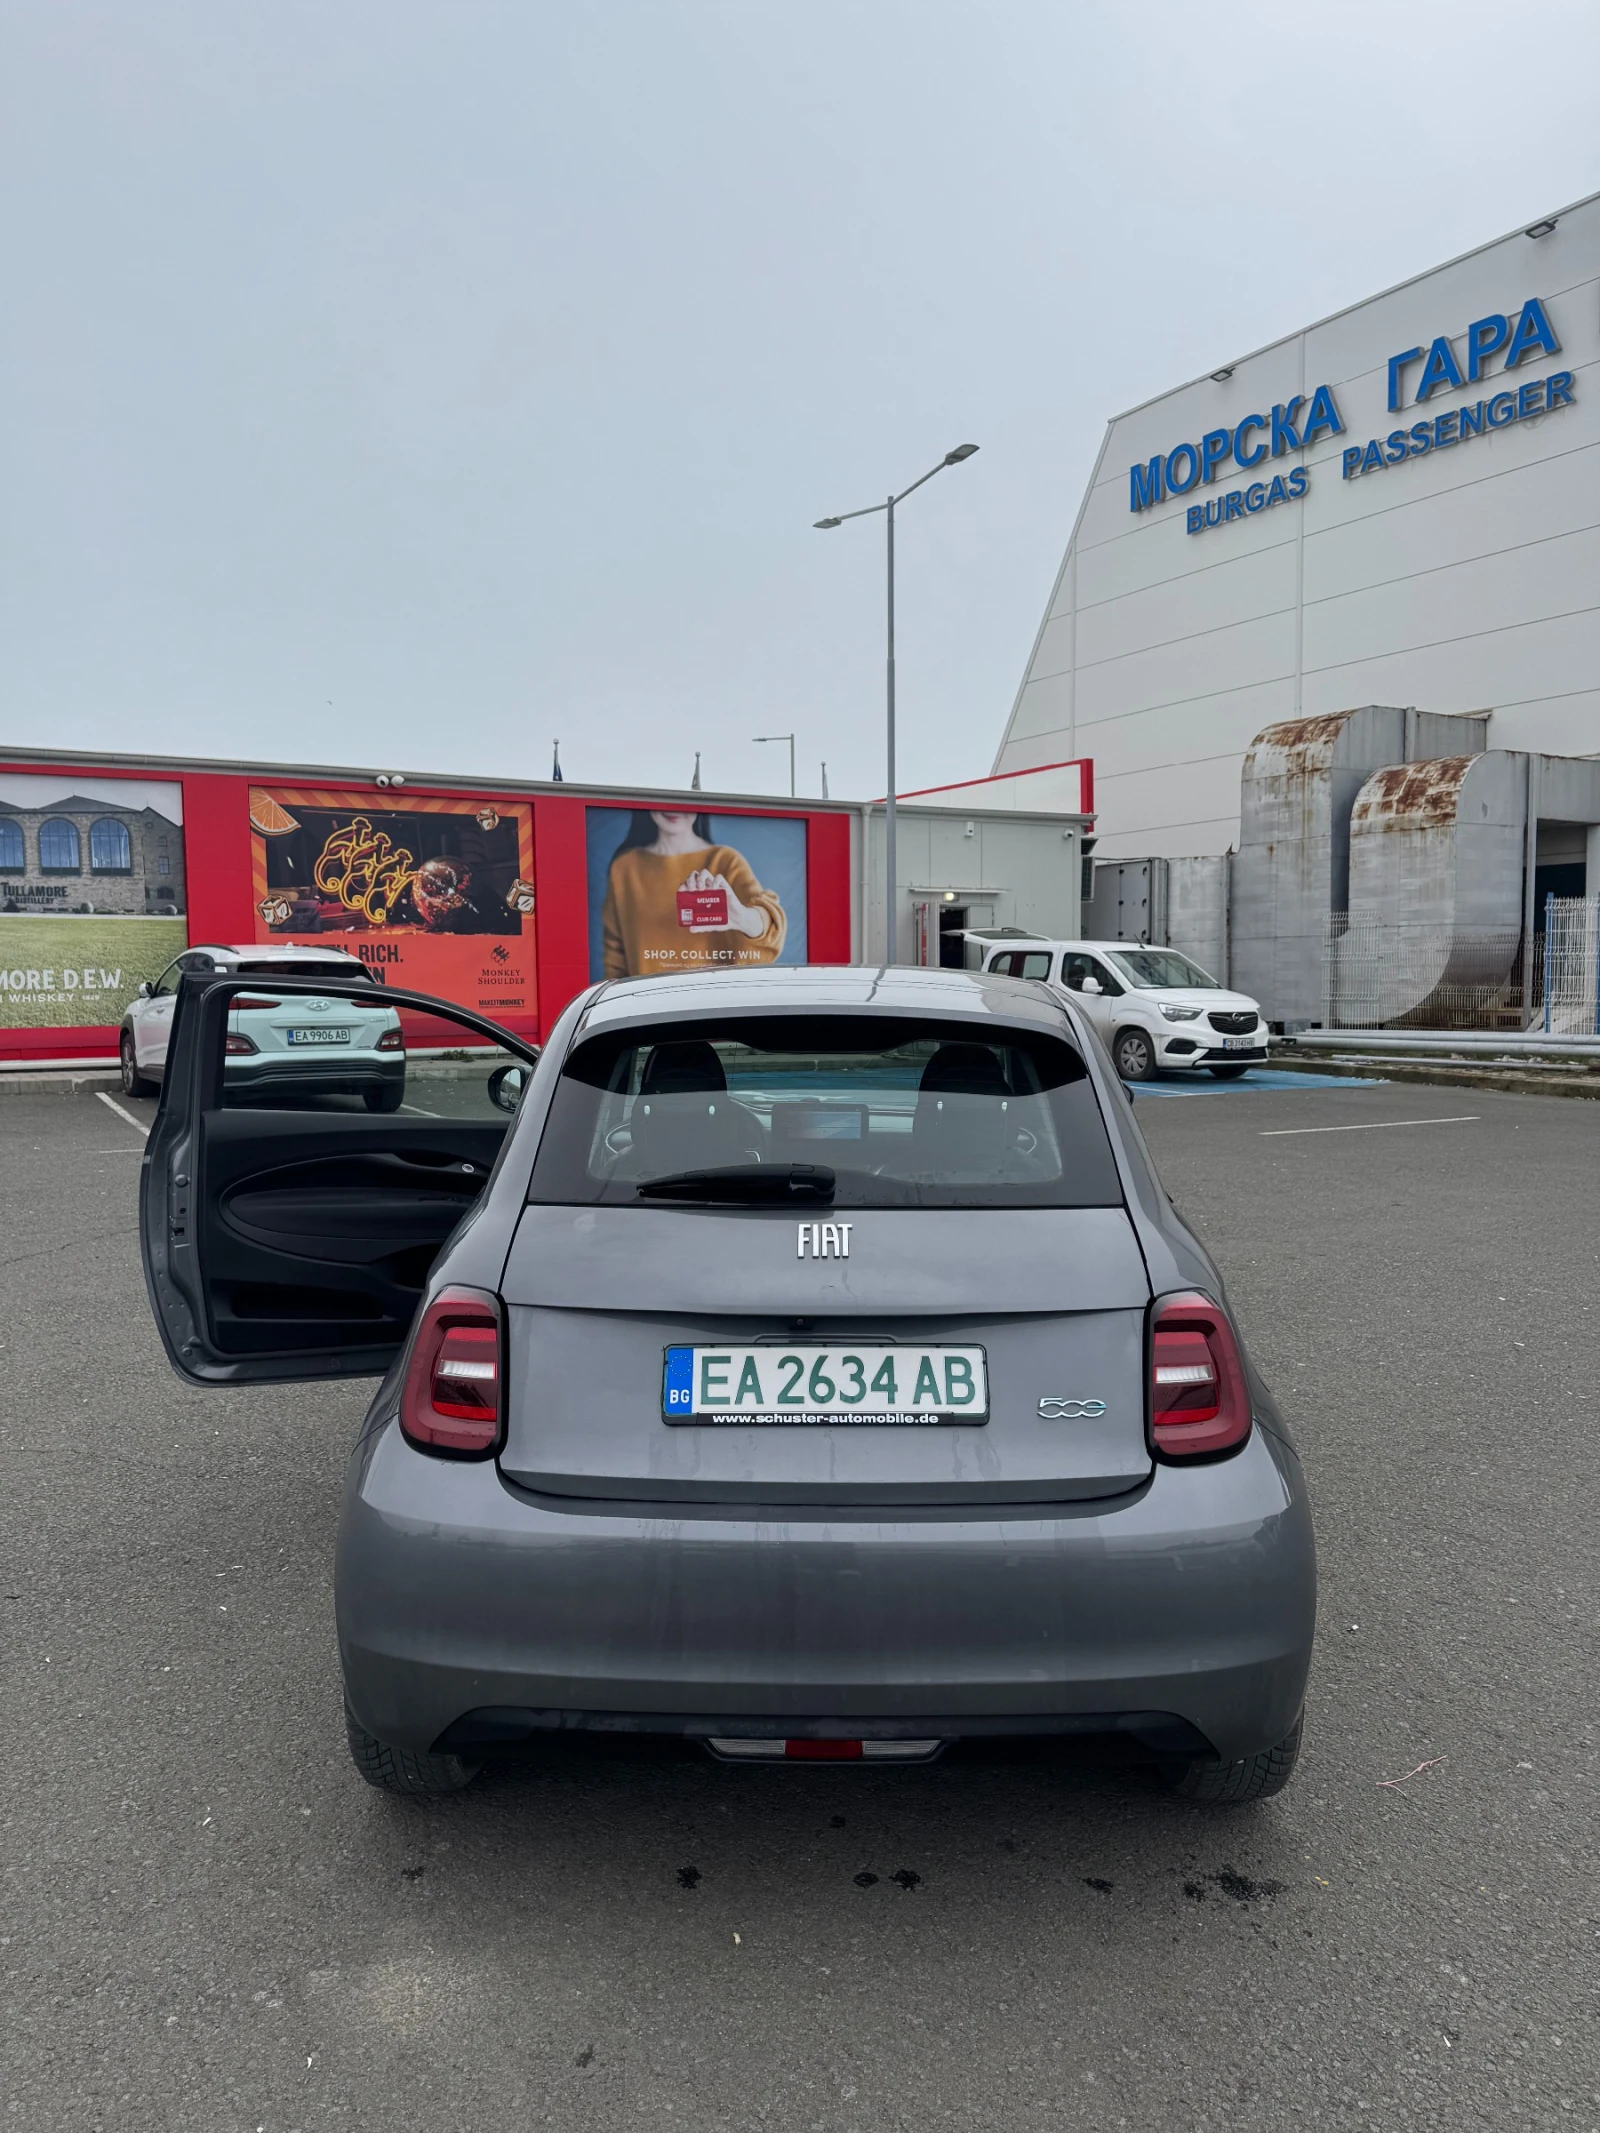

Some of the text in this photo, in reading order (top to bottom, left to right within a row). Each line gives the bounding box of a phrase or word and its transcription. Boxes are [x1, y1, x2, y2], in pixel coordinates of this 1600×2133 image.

[1130, 297, 1562, 512] МОРСКА ГАРА
[1187, 371, 1576, 535] BURGAS PASSENGER
[0, 882, 68, 897] TULLAMORE
[359, 944, 403, 962] RICH.
[644, 950, 760, 960] SHOP. COLLECT. WIN
[63, 969, 124, 989] D.E.W.
[478, 977, 525, 985] SHOULDER
[9, 993, 74, 1003] WHISKEY
[295, 1030, 348, 1041] EA 9906 AB
[797, 1223, 852, 1258] FIAT
[700, 1355, 976, 1405] EA 2634 AB
[669, 1389, 690, 1404] BG
[712, 1413, 939, 1425] www.schuster-automobile.de
